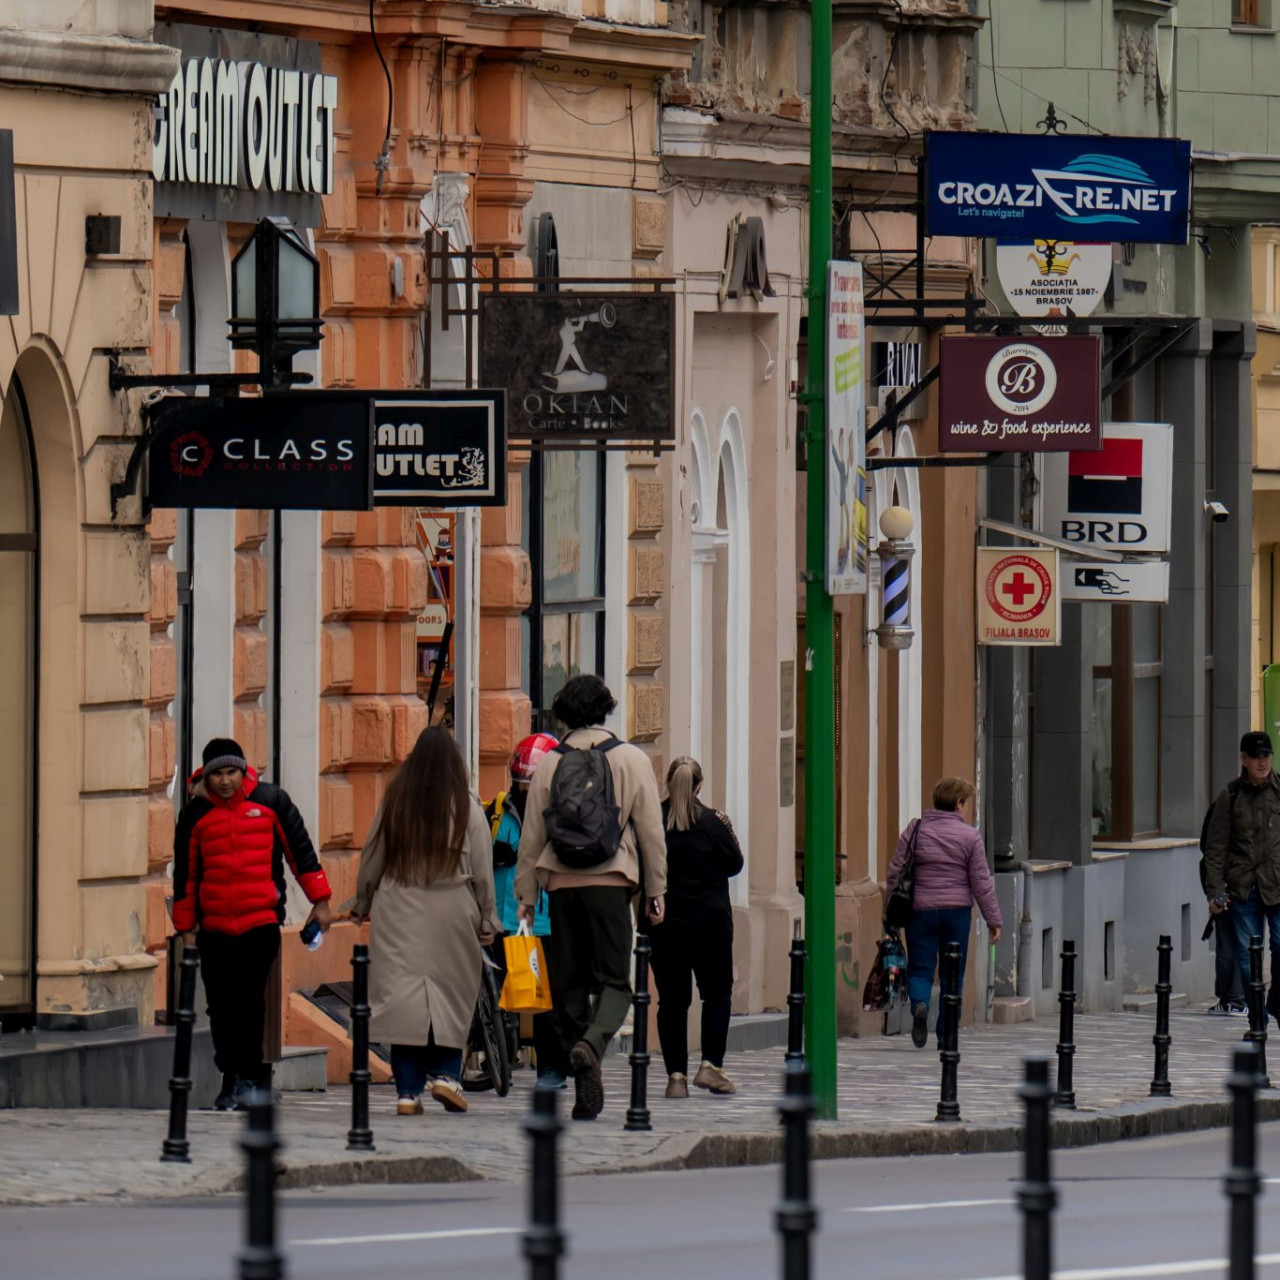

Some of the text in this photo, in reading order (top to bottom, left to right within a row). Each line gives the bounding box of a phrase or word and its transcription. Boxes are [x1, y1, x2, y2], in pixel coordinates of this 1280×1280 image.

[246, 62, 338, 195] OUTLET
[1025, 288, 1074, 296] NOIEMBRIE
[886, 341, 922, 387] RIVAL
[1001, 362, 1037, 394] B
[523, 394, 629, 414] OKIAN
[528, 416, 625, 429] Carte Books
[950, 419, 1091, 441] wine & food experience
[374, 423, 424, 446] AM
[223, 439, 354, 460] CLASS
[223, 462, 353, 471] COLLECTION
[374, 454, 459, 476] UTLET
[1061, 520, 1148, 543] BRD
[417, 615, 443, 625] OOKS
[985, 628, 1017, 638] FILIALA
